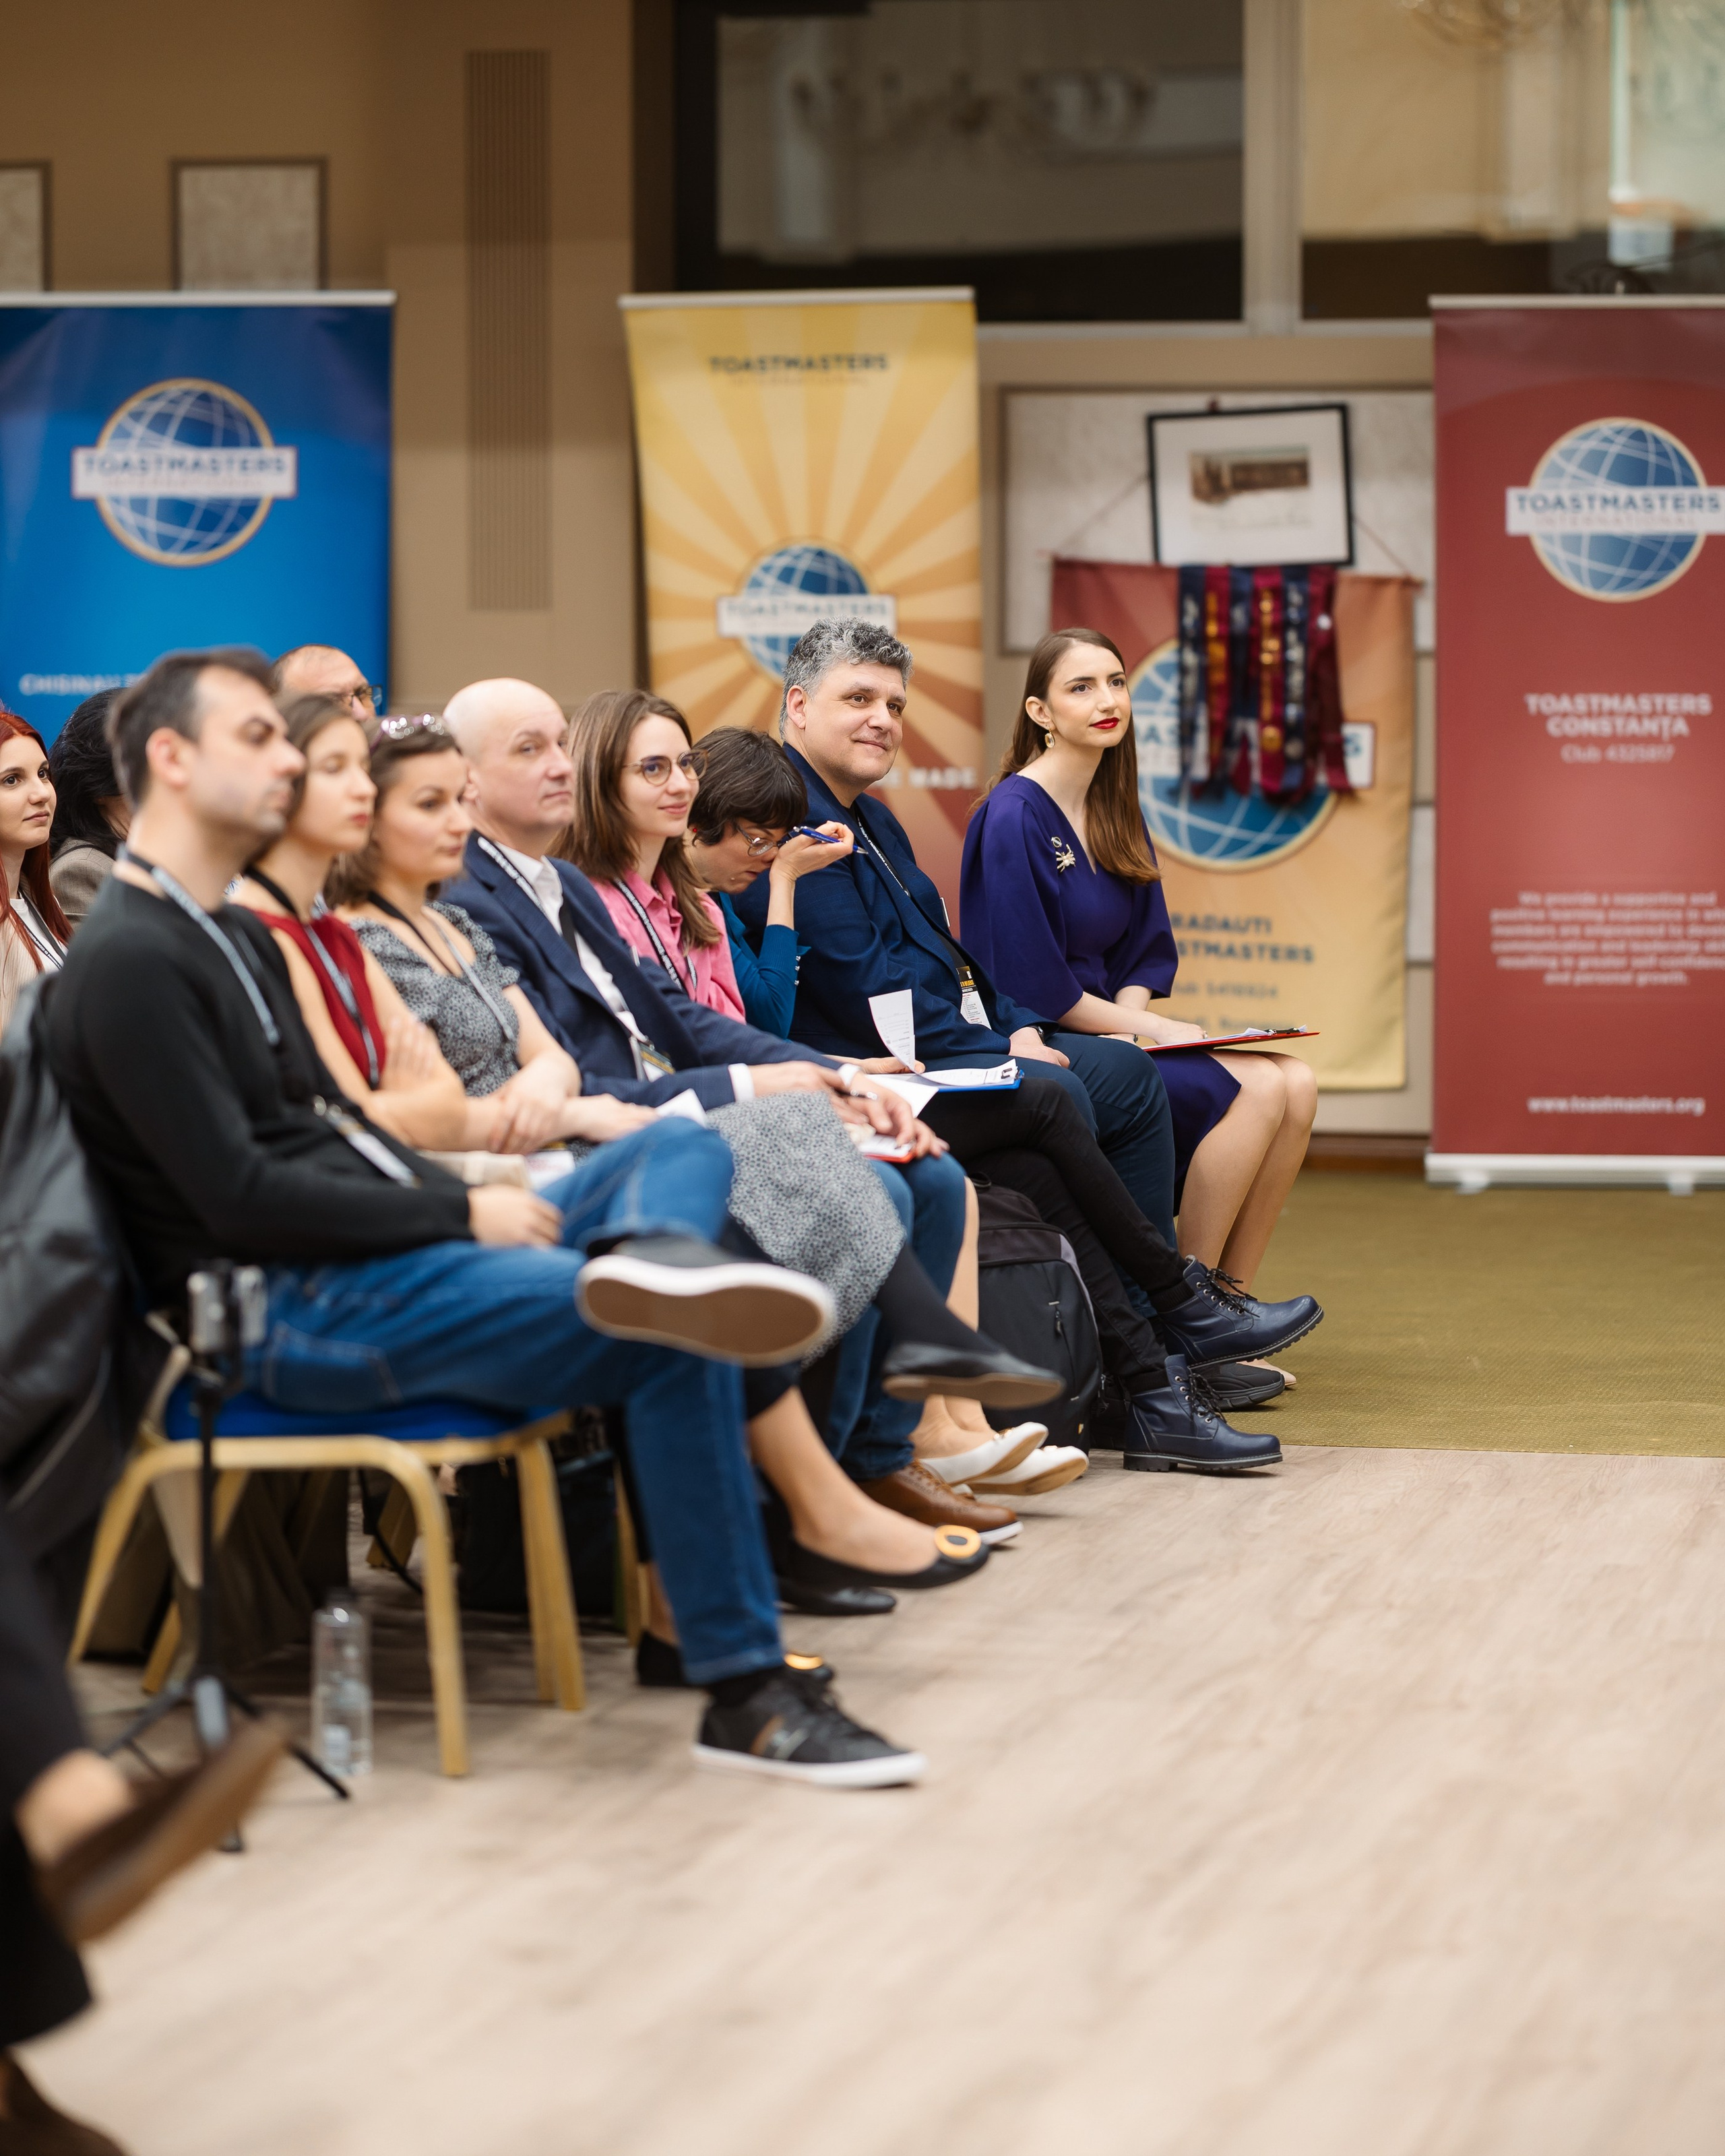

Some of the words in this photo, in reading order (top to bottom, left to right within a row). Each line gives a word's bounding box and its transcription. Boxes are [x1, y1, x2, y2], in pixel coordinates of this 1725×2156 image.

[710, 354, 888, 374] TOASTMASTERS
[85, 456, 286, 475] TOASTMASTERS
[1517, 493, 1722, 513] TOASTMASTERS
[1524, 693, 1712, 715] TOASTMASTERS
[1561, 744, 1602, 763] Club
[909, 767, 976, 789] MADE
[1179, 940, 1315, 962] STMASTERS
[1527, 1096, 1705, 1116] www.toastmasters.org
